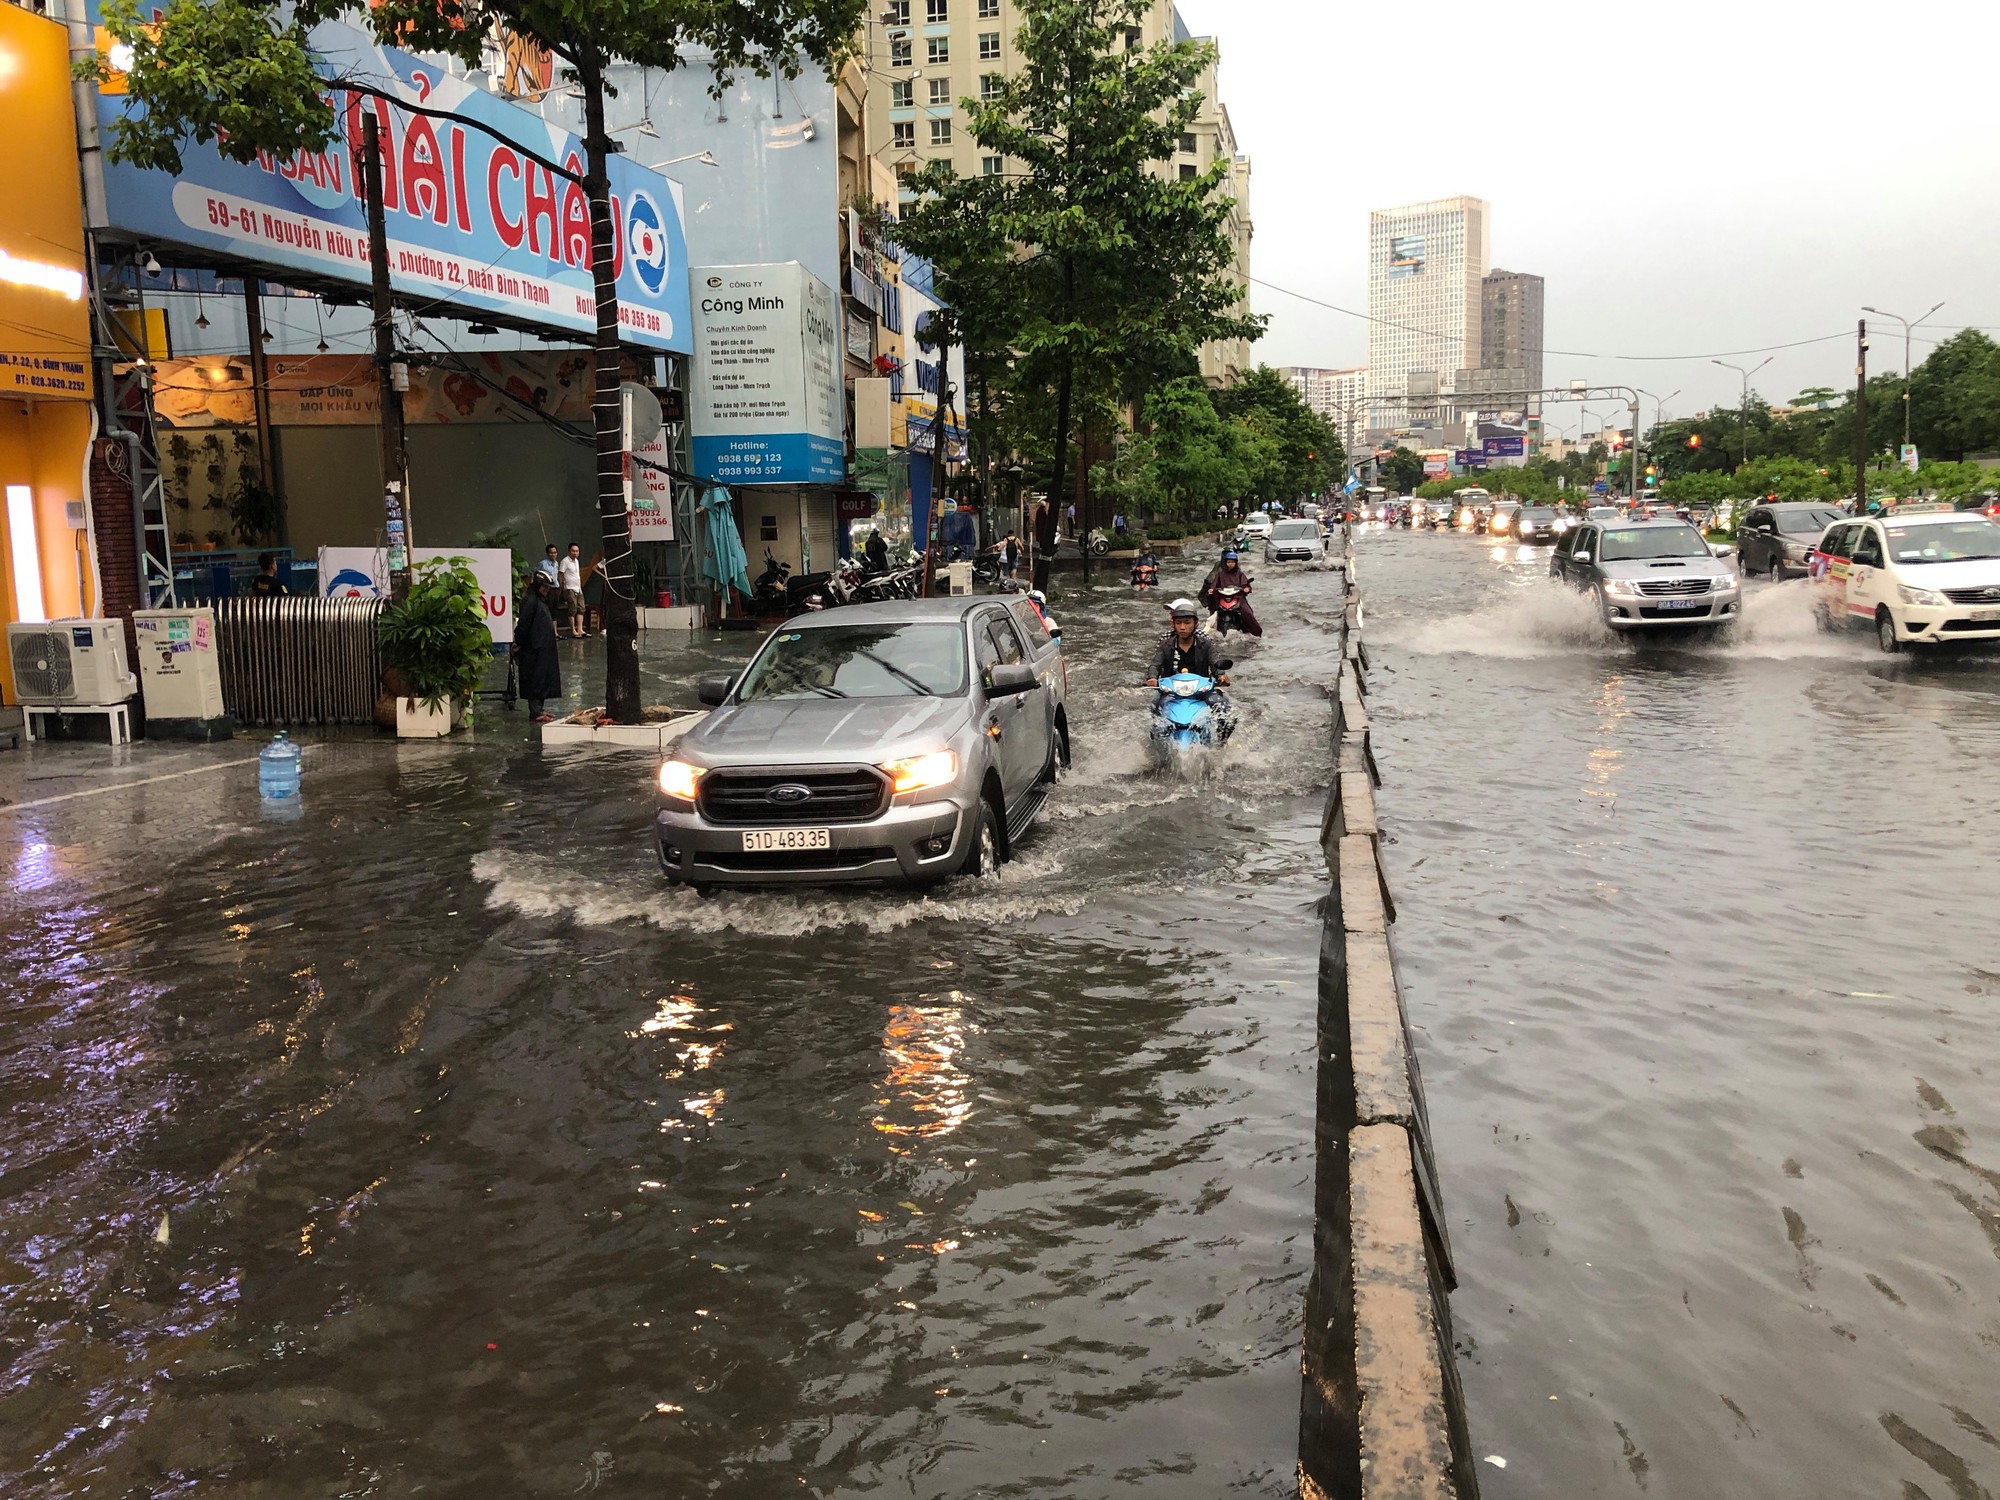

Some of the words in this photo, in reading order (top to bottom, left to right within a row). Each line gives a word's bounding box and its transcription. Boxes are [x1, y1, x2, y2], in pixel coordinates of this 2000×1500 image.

[346, 71, 473, 234] HẢI
[207, 198, 258, 235] 59-61
[263, 213, 322, 251] Nguyễn
[326, 230, 353, 259] Hữu
[399, 251, 443, 281] phường
[447, 261, 464, 285] 22,
[468, 268, 494, 294] quận
[497, 274, 520, 298] Bình
[522, 280, 550, 306] Thạnh
[729, 280, 751, 289] CÔNG
[701, 298, 743, 315] Công
[748, 296, 784, 310] Minh
[632, 309, 645, 329] 355
[647, 314, 660, 332] 366
[706, 325, 729, 333] Chuyên
[747, 324, 767, 332] Doanh
[20, 356, 33, 369] 22,
[300, 402, 323, 414] MỌI
[730, 441, 769, 450] Hotline:
[718, 454, 741, 463] 0938
[765, 453, 782, 462] 123
[718, 467, 742, 476] 0938
[744, 467, 762, 475] 993
[765, 466, 782, 474] 537
[842, 500, 866, 511] GOLF
[635, 518, 650, 527] 355
[652, 517, 668, 526] 366
[776, 789, 800, 800] Ford
[745, 830, 827, 850] 51D-483.35
